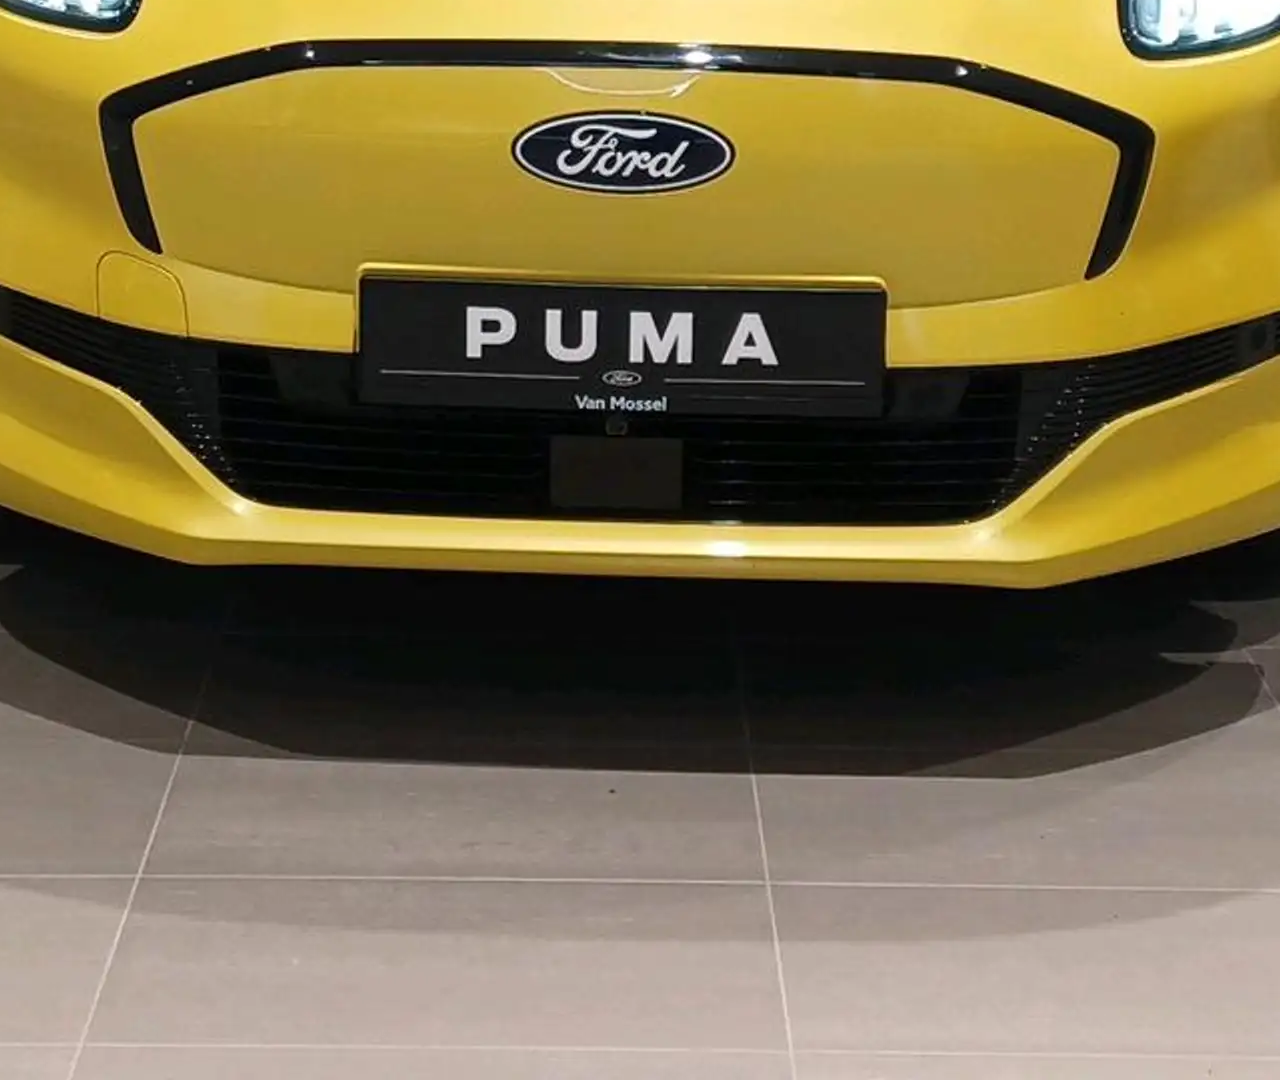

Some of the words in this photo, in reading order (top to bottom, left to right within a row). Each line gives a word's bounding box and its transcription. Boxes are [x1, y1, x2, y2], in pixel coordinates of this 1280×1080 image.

[556, 124, 690, 178] Ford
[466, 306, 779, 366] PUMA
[574, 394, 606, 410] Van
[610, 395, 668, 412] Mossel
